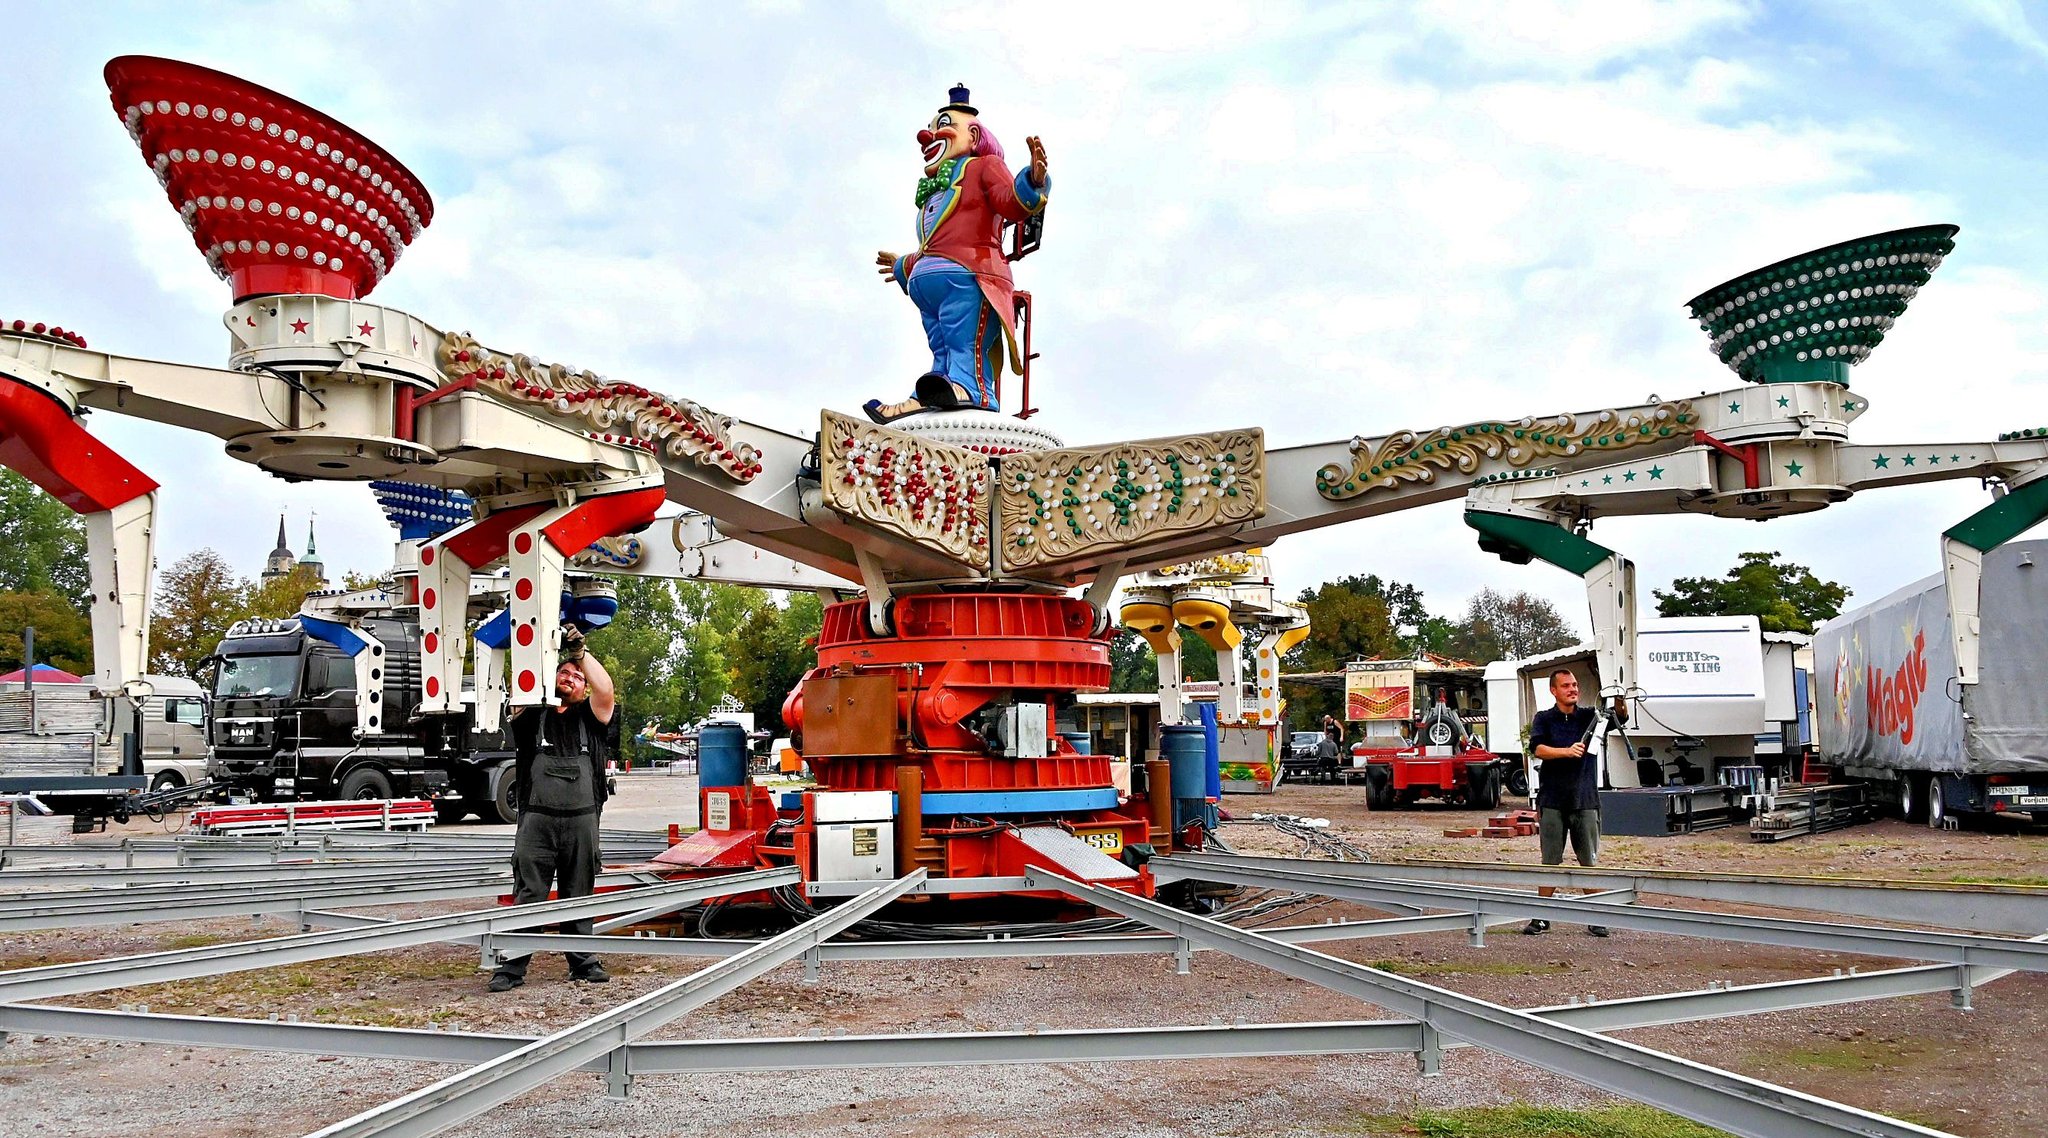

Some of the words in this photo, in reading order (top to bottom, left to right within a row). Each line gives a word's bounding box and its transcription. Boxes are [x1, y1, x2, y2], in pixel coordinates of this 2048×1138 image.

[1648, 651, 1701, 662] COUNTRY
[1693, 662, 1721, 673] KING
[1866, 626, 1927, 745] Magic
[231, 728, 254, 737] MAN
